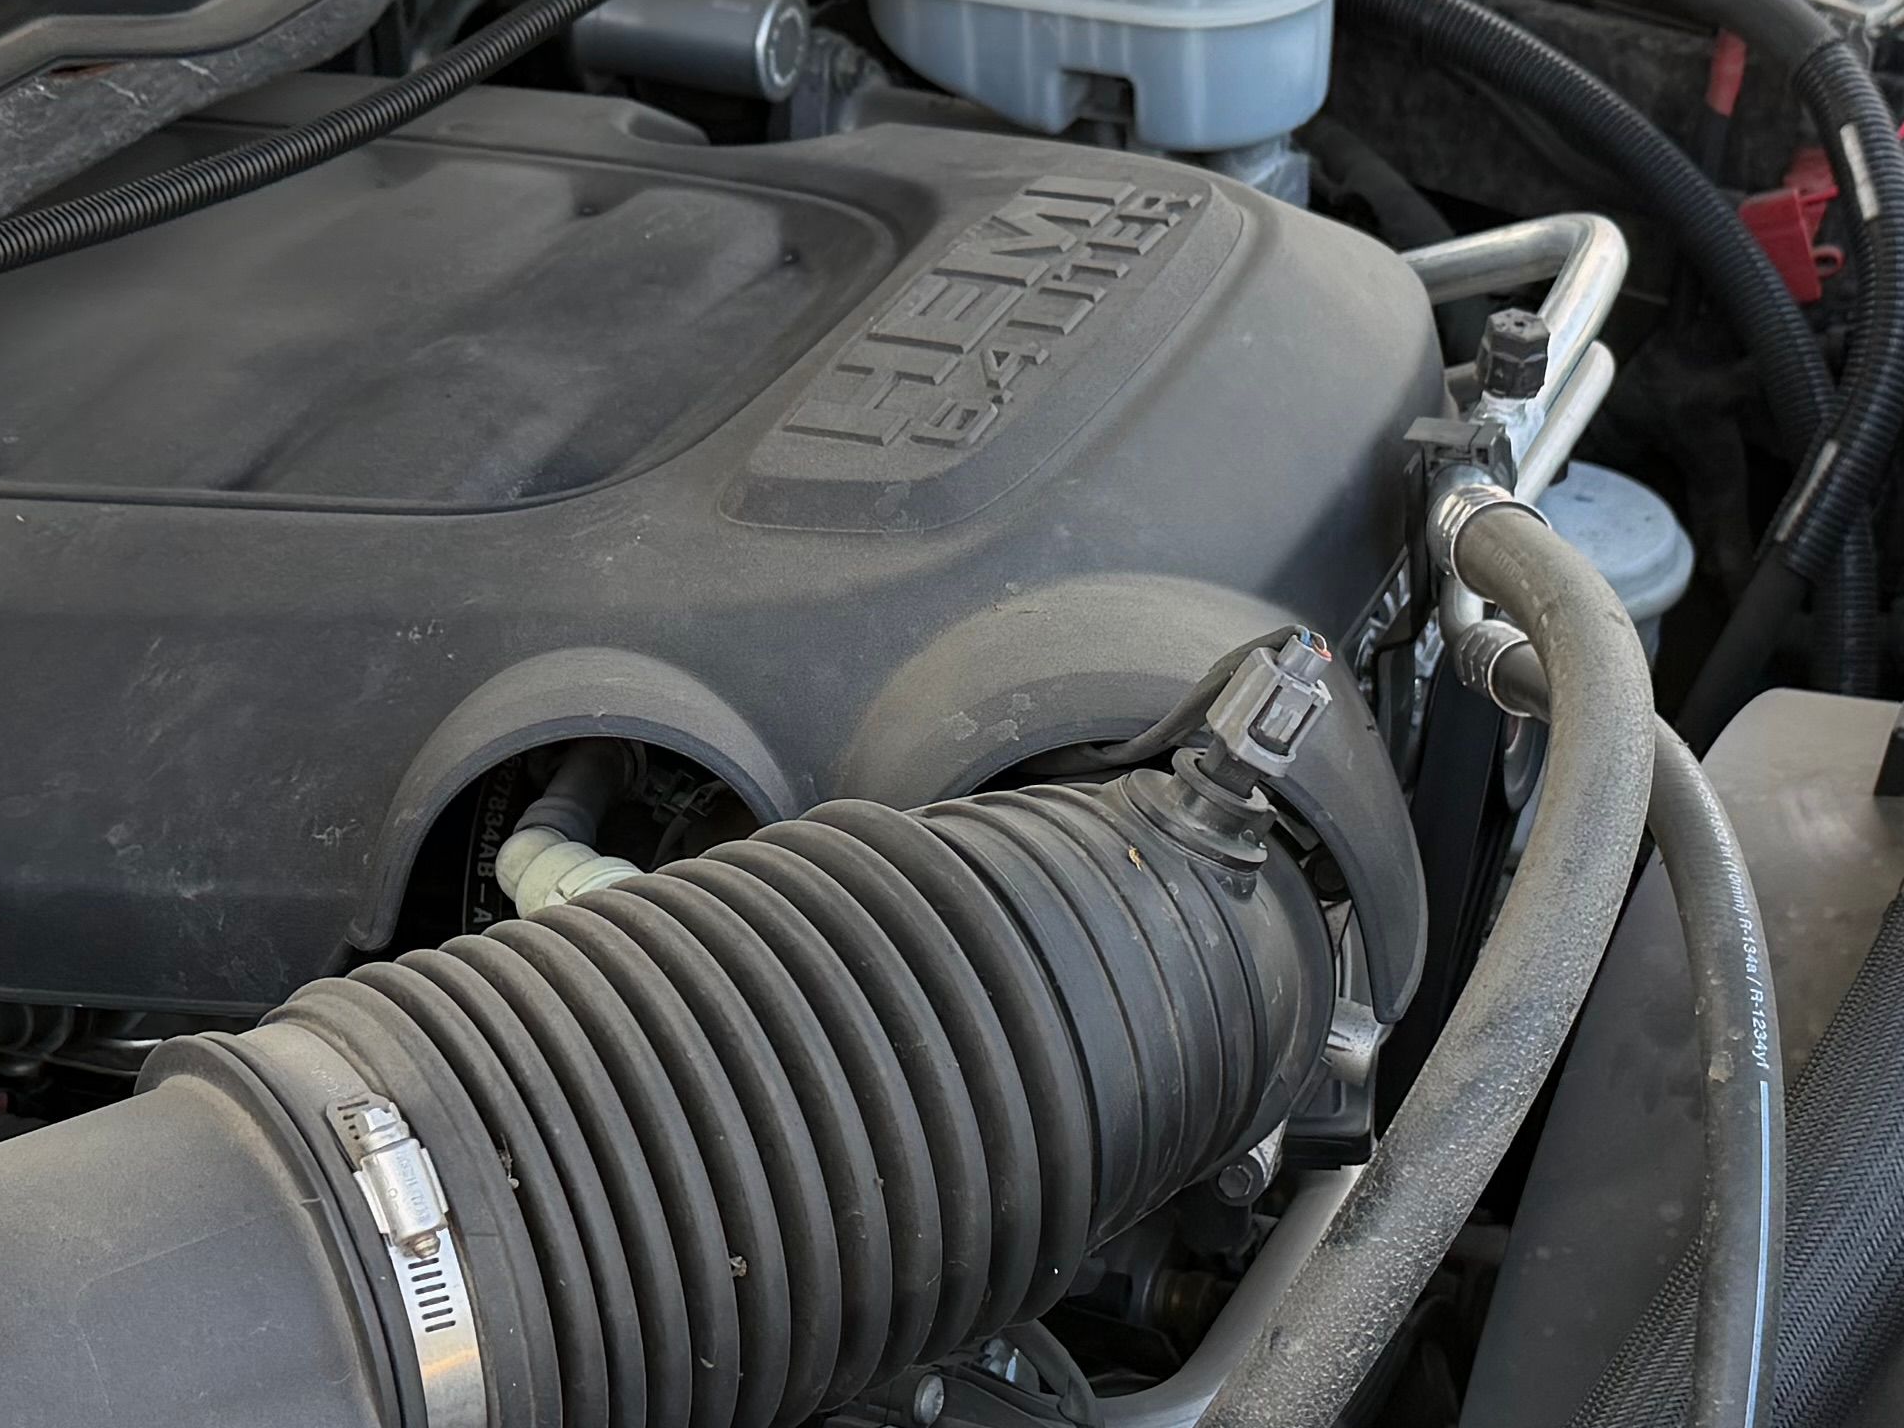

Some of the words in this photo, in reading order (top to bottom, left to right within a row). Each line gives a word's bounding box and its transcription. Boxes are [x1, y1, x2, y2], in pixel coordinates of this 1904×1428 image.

[784, 175, 1137, 447] HEMI
[1008, 189, 1202, 336] LITER
[1722, 858, 1749, 915] (10mm)
[1738, 916, 1757, 973] R-134a
[1750, 987, 1769, 1069] R-1234yf
